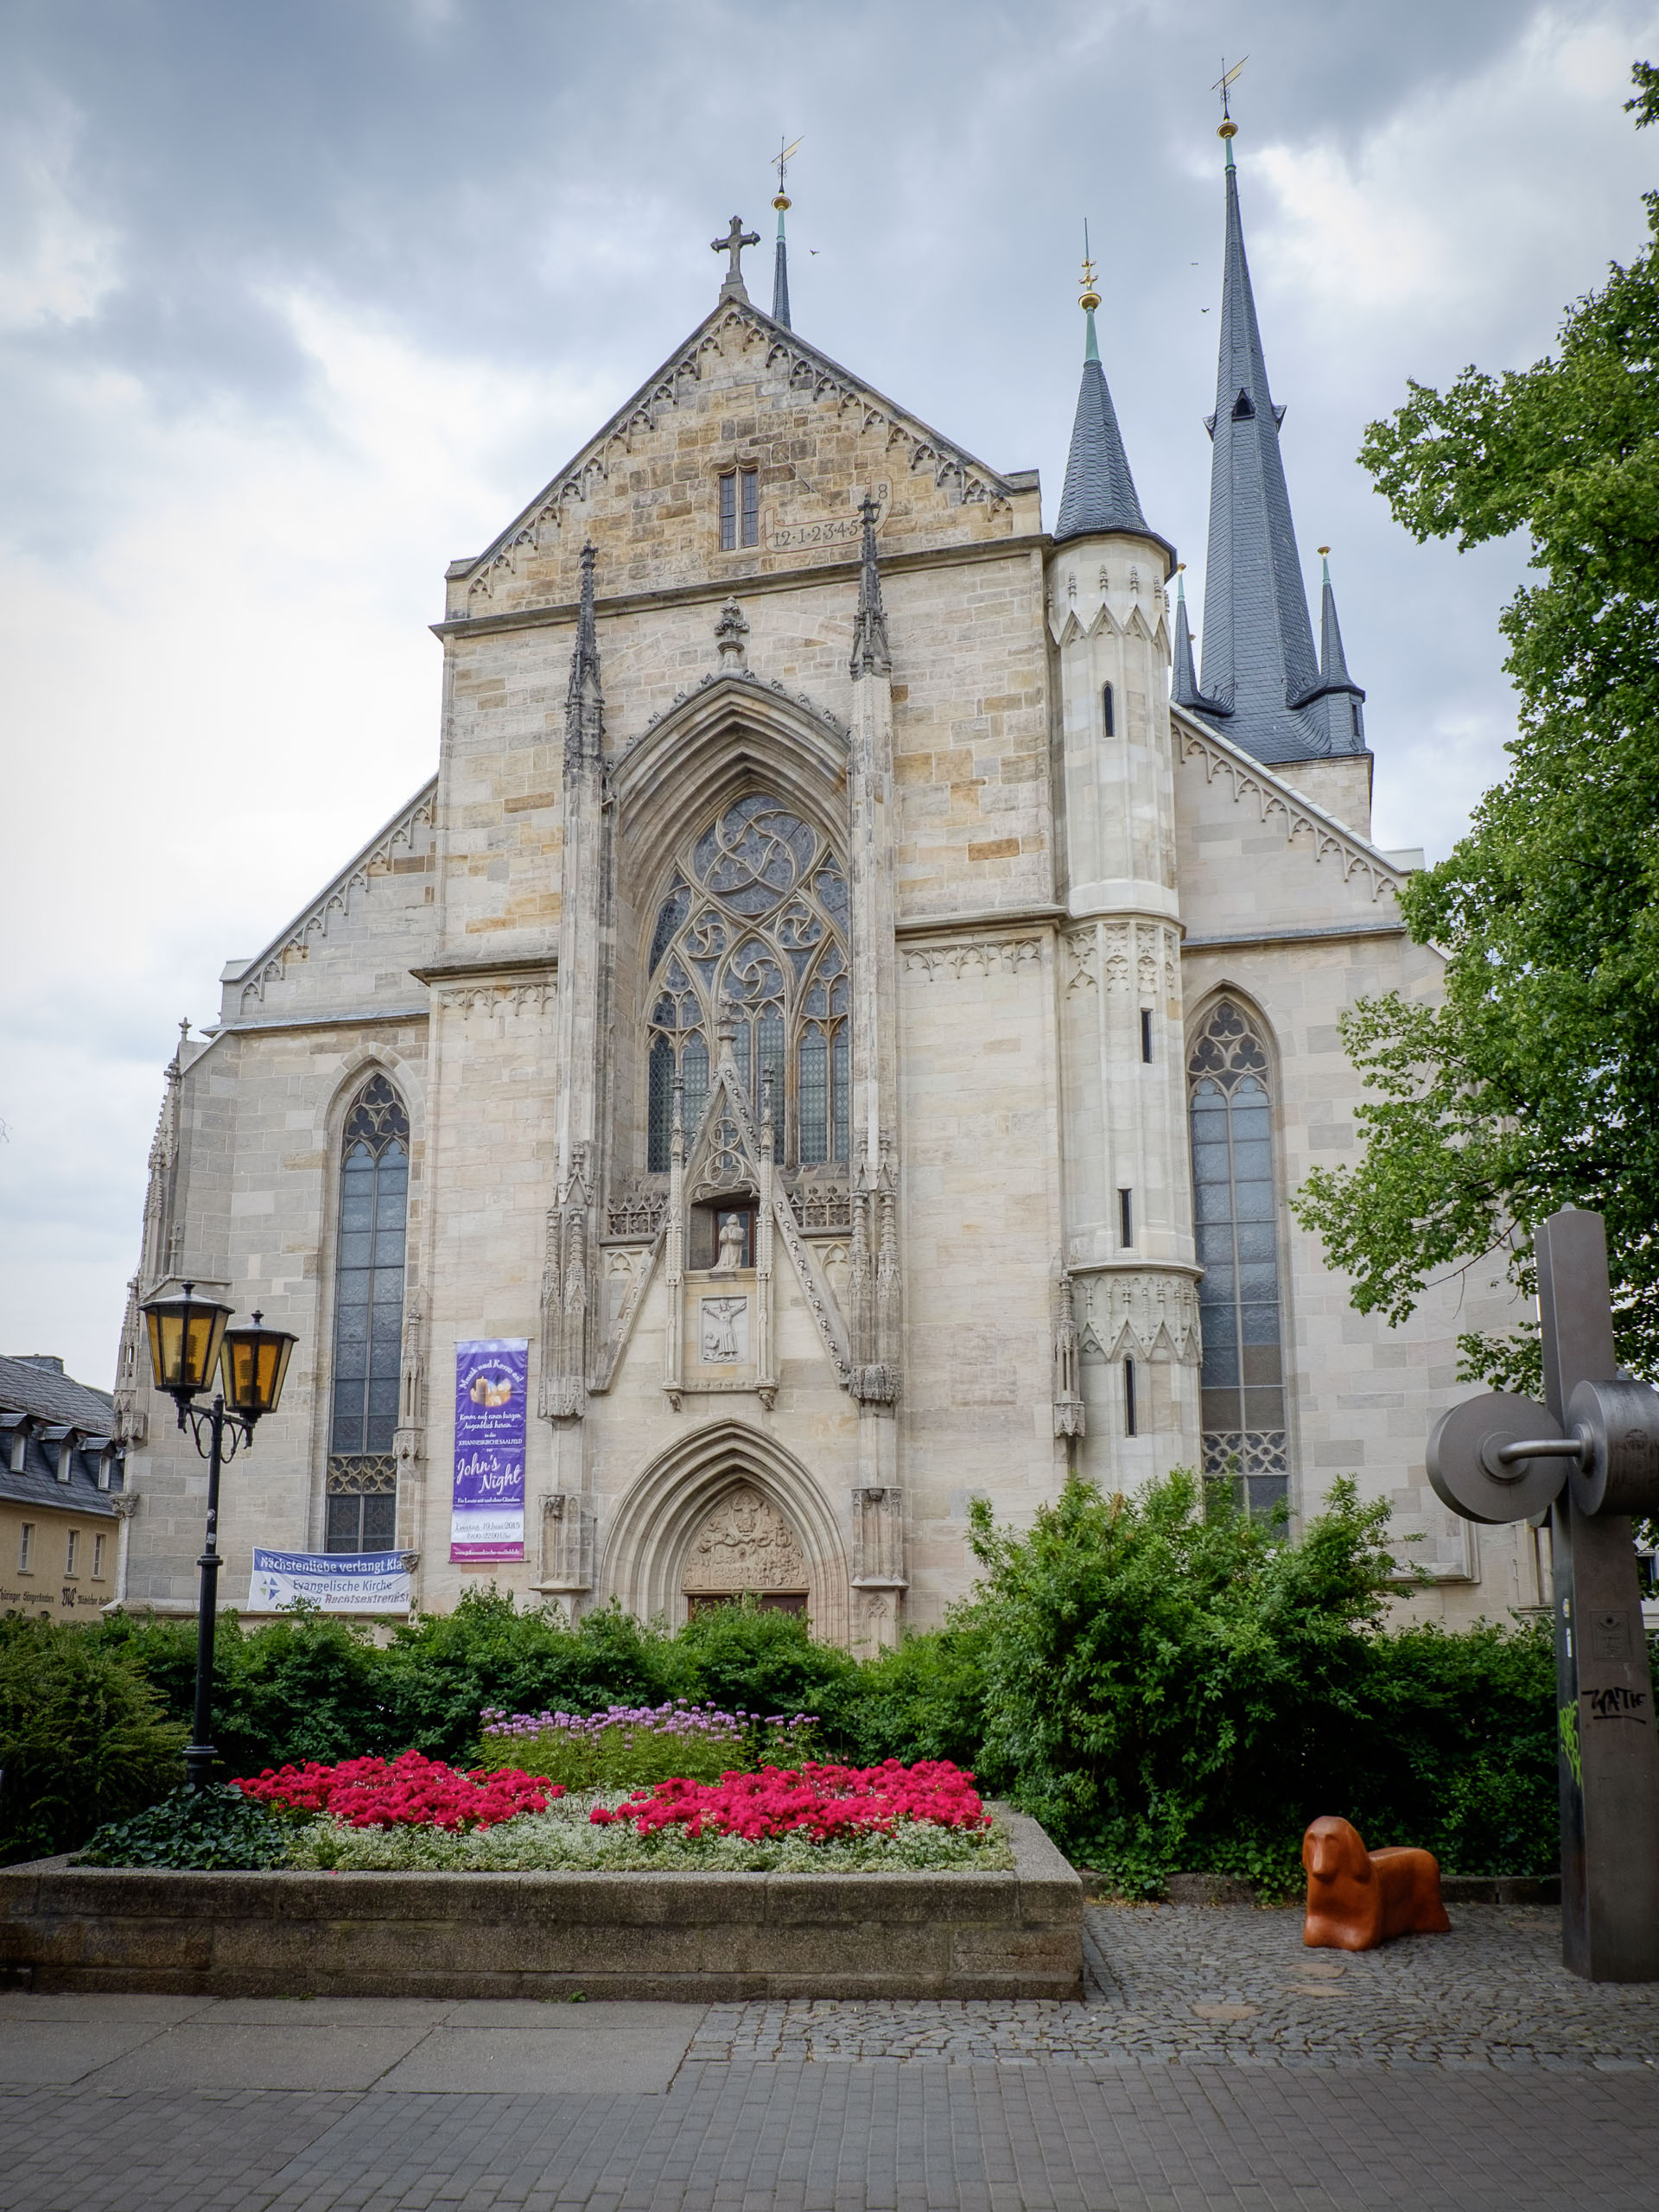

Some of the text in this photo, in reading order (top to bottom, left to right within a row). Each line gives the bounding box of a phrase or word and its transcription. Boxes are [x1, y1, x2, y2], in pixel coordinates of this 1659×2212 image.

[879, 484, 888, 499] 8
[456, 1452, 501, 1484] John's
[478, 1464, 523, 1495] Night
[260, 1556, 337, 1572] Nächstenliebe
[339, 1560, 385, 1575] verlangt
[293, 1580, 393, 1594] Evangelische Kirche
